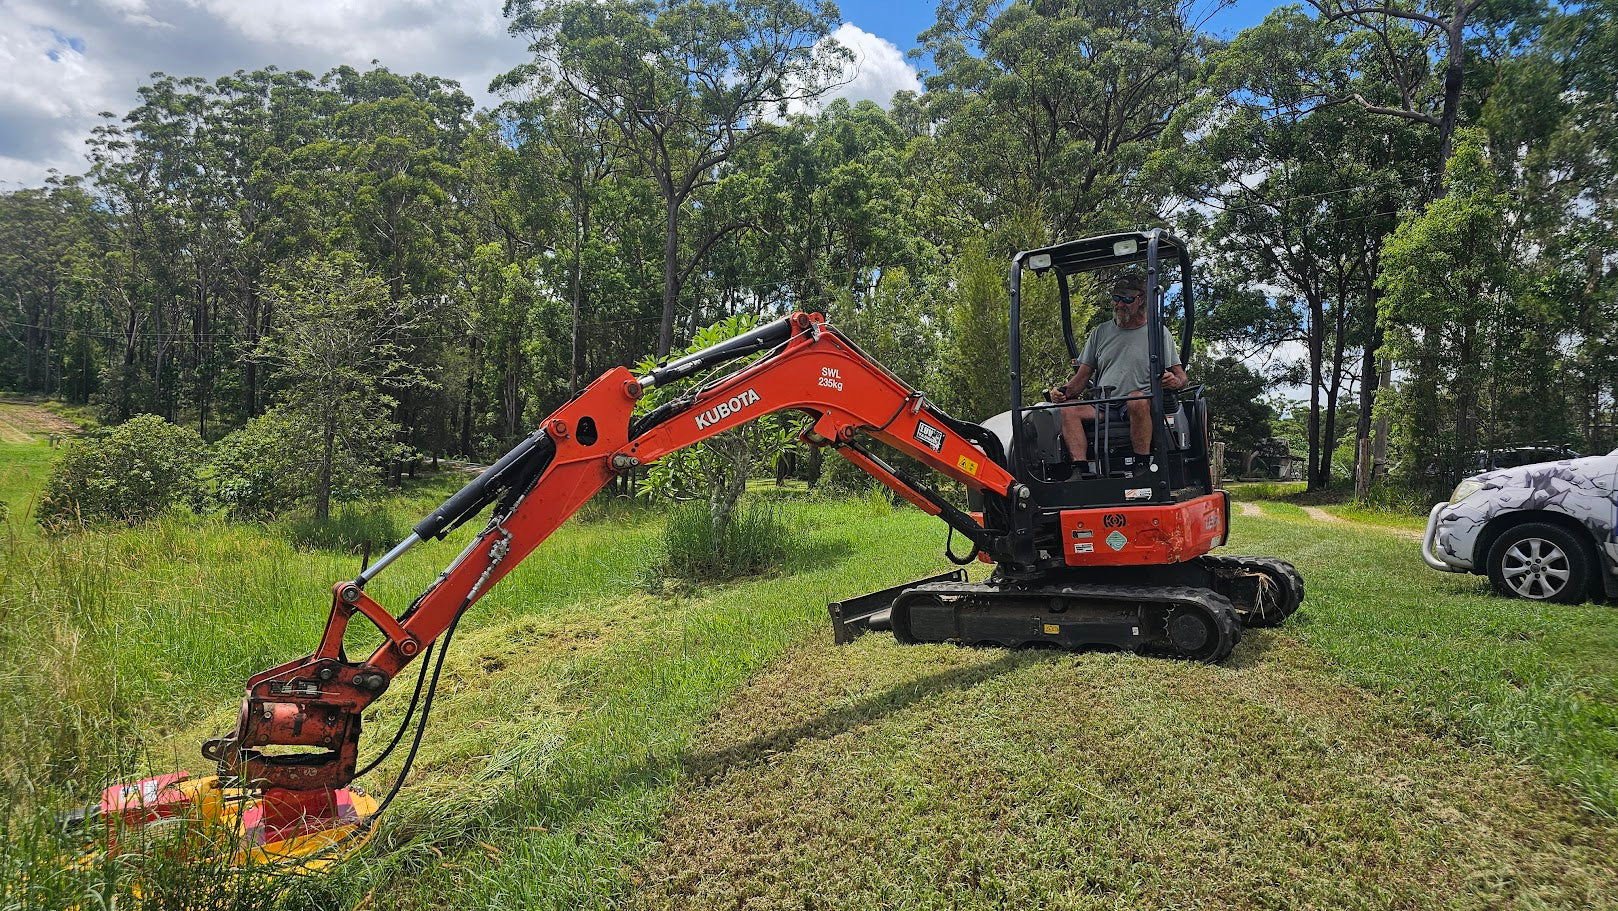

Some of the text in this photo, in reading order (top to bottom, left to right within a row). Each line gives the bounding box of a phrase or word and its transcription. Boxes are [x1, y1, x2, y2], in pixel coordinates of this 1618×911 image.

[821, 367, 841, 379] SWL
[818, 377, 843, 391] 235kg
[694, 388, 761, 430] KUBOTA
